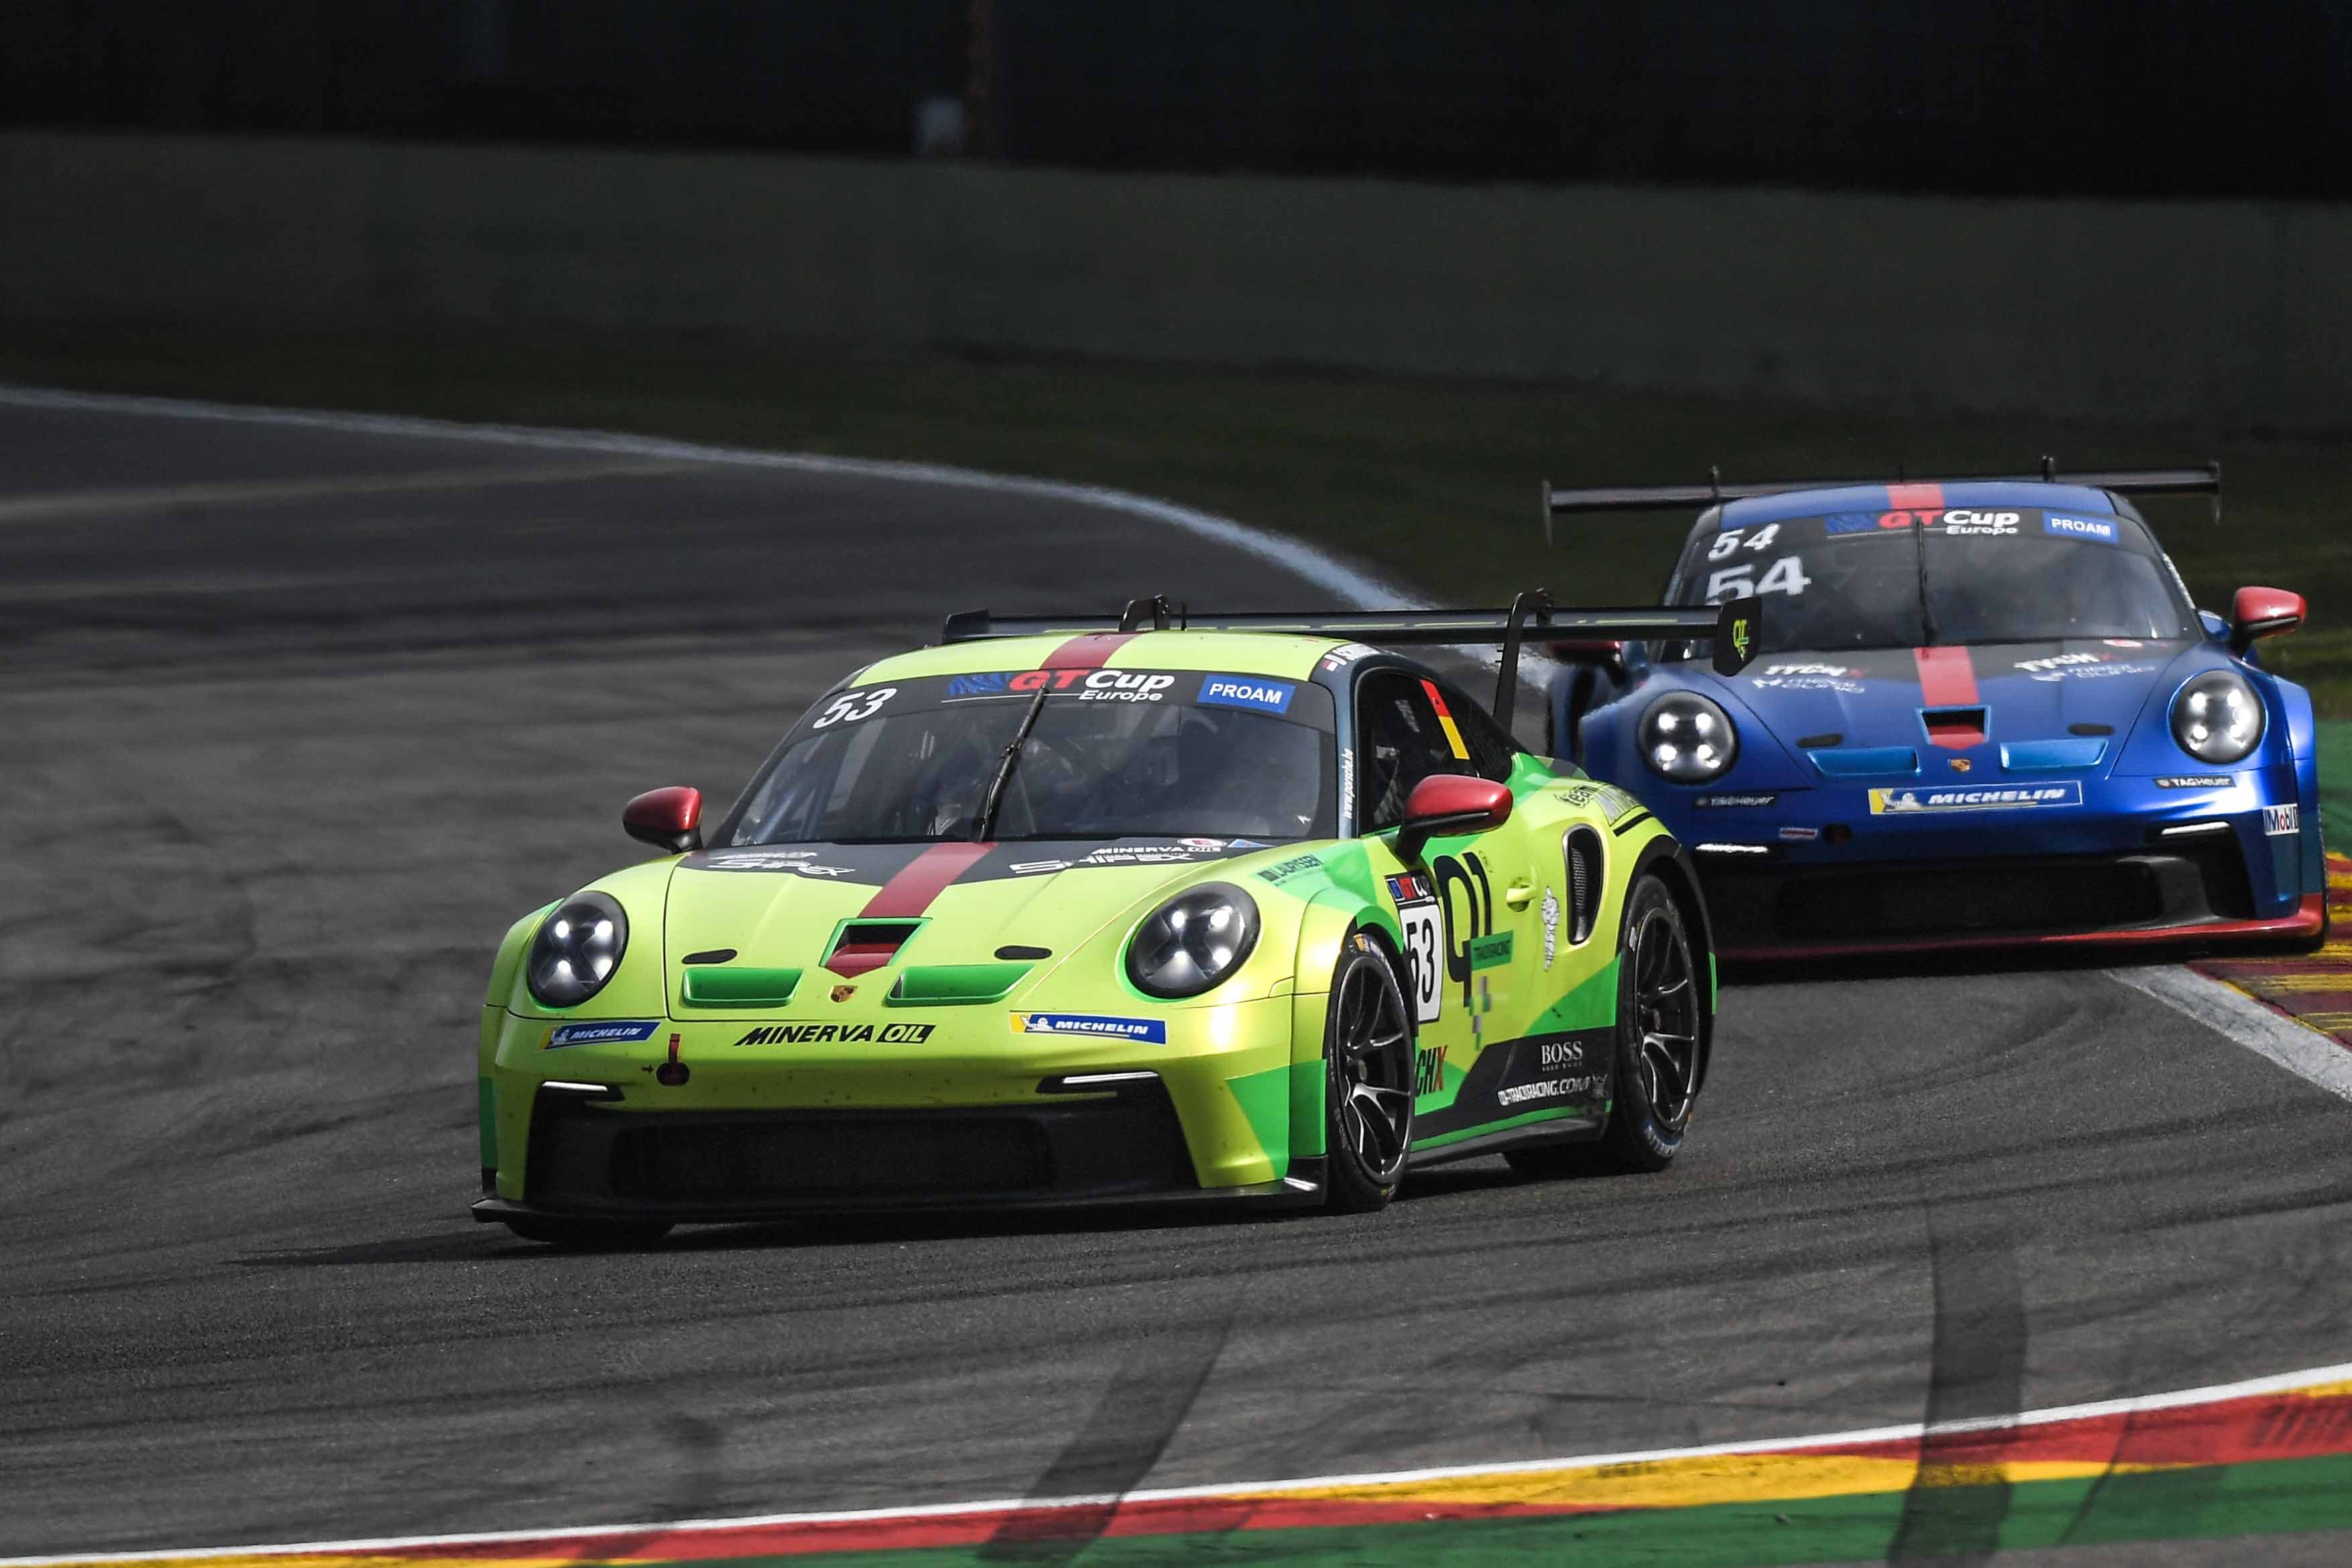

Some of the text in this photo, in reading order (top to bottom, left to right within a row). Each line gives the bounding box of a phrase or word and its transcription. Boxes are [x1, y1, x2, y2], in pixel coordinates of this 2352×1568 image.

[1879, 509, 2020, 528] GT Cup
[2050, 518, 2111, 536] PROAM
[1946, 525, 2018, 536] Europe
[1708, 522, 1780, 562] 54
[1009, 670, 1175, 692] GT Cup
[1078, 690, 1163, 703] Europe
[1208, 682, 1283, 705] PROAM
[813, 688, 898, 729] 53
[1928, 788, 2066, 804] MICHELIN
[1091, 847, 1186, 855] MINERVA
[1406, 918, 1435, 1004] 53
[570, 1027, 643, 1040] MICHELIN
[732, 1024, 925, 1046] MINERVA OIL
[1055, 1020, 1149, 1035] MICHELIN
[1541, 1040, 1583, 1065] BOSS
